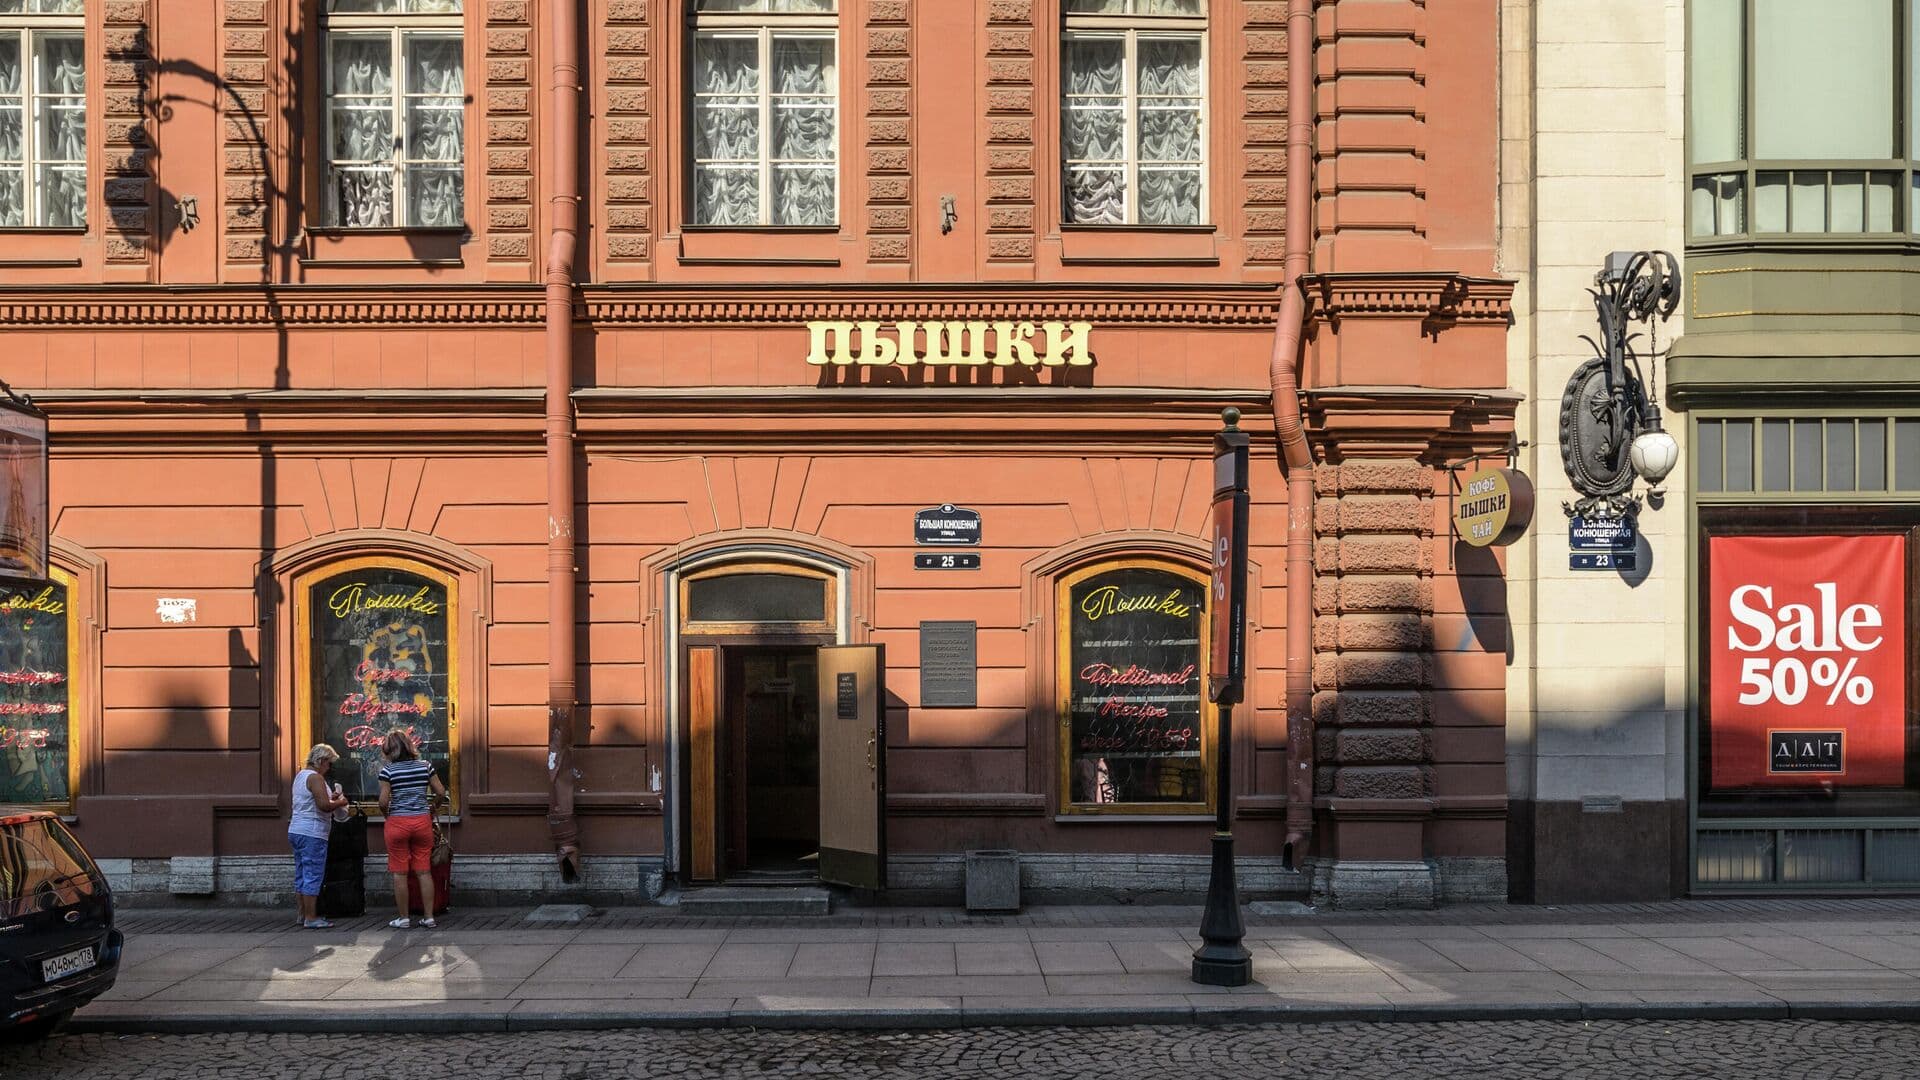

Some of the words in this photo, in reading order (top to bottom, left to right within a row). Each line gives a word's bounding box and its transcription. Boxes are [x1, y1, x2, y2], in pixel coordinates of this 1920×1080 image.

[806, 321, 1092, 365] ПЫШКИ
[1469, 477, 1495, 496] КОФЕ
[1461, 494, 1506, 519] ПЫШКИ
[920, 520, 943, 529] БОЛЬШАЯ
[944, 520, 977, 529] КОНЮШЕННАЯ
[1472, 519, 1492, 538] ЧАЙ
[1573, 529, 1631, 537] КОНЮШЕННАЯ
[1213, 525, 1228, 567] le
[942, 556, 954, 567] 25
[1596, 555, 1609, 566] 23
[329, 583, 438, 618] Пышки
[1082, 585, 1190, 620] Пышки
[1728, 582, 1883, 652] Sale
[1081, 664, 1195, 687] Traditional
[1738, 657, 1873, 706] 50%
[1102, 696, 1168, 723] Recipe
